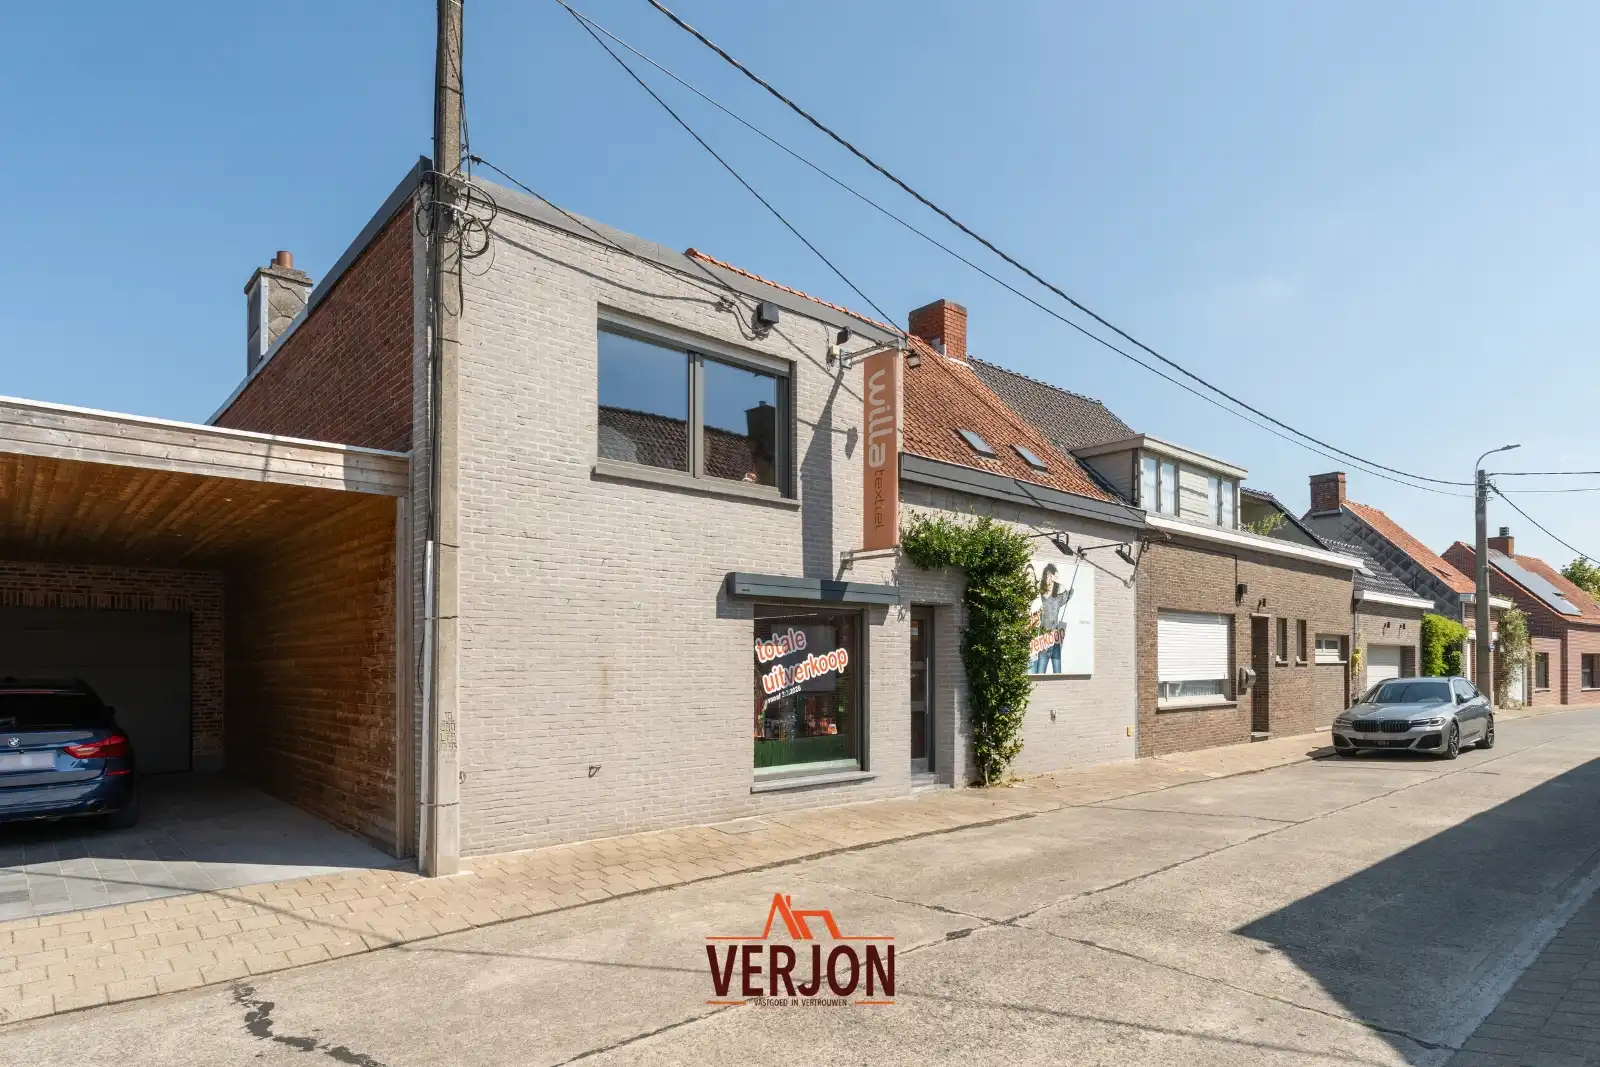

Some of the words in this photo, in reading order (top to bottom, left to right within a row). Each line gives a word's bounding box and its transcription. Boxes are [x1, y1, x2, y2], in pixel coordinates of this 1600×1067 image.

[868, 368, 893, 468] willa
[874, 469, 885, 531] textiel
[755, 627, 807, 663] totale
[762, 648, 848, 694] uitverkoop
